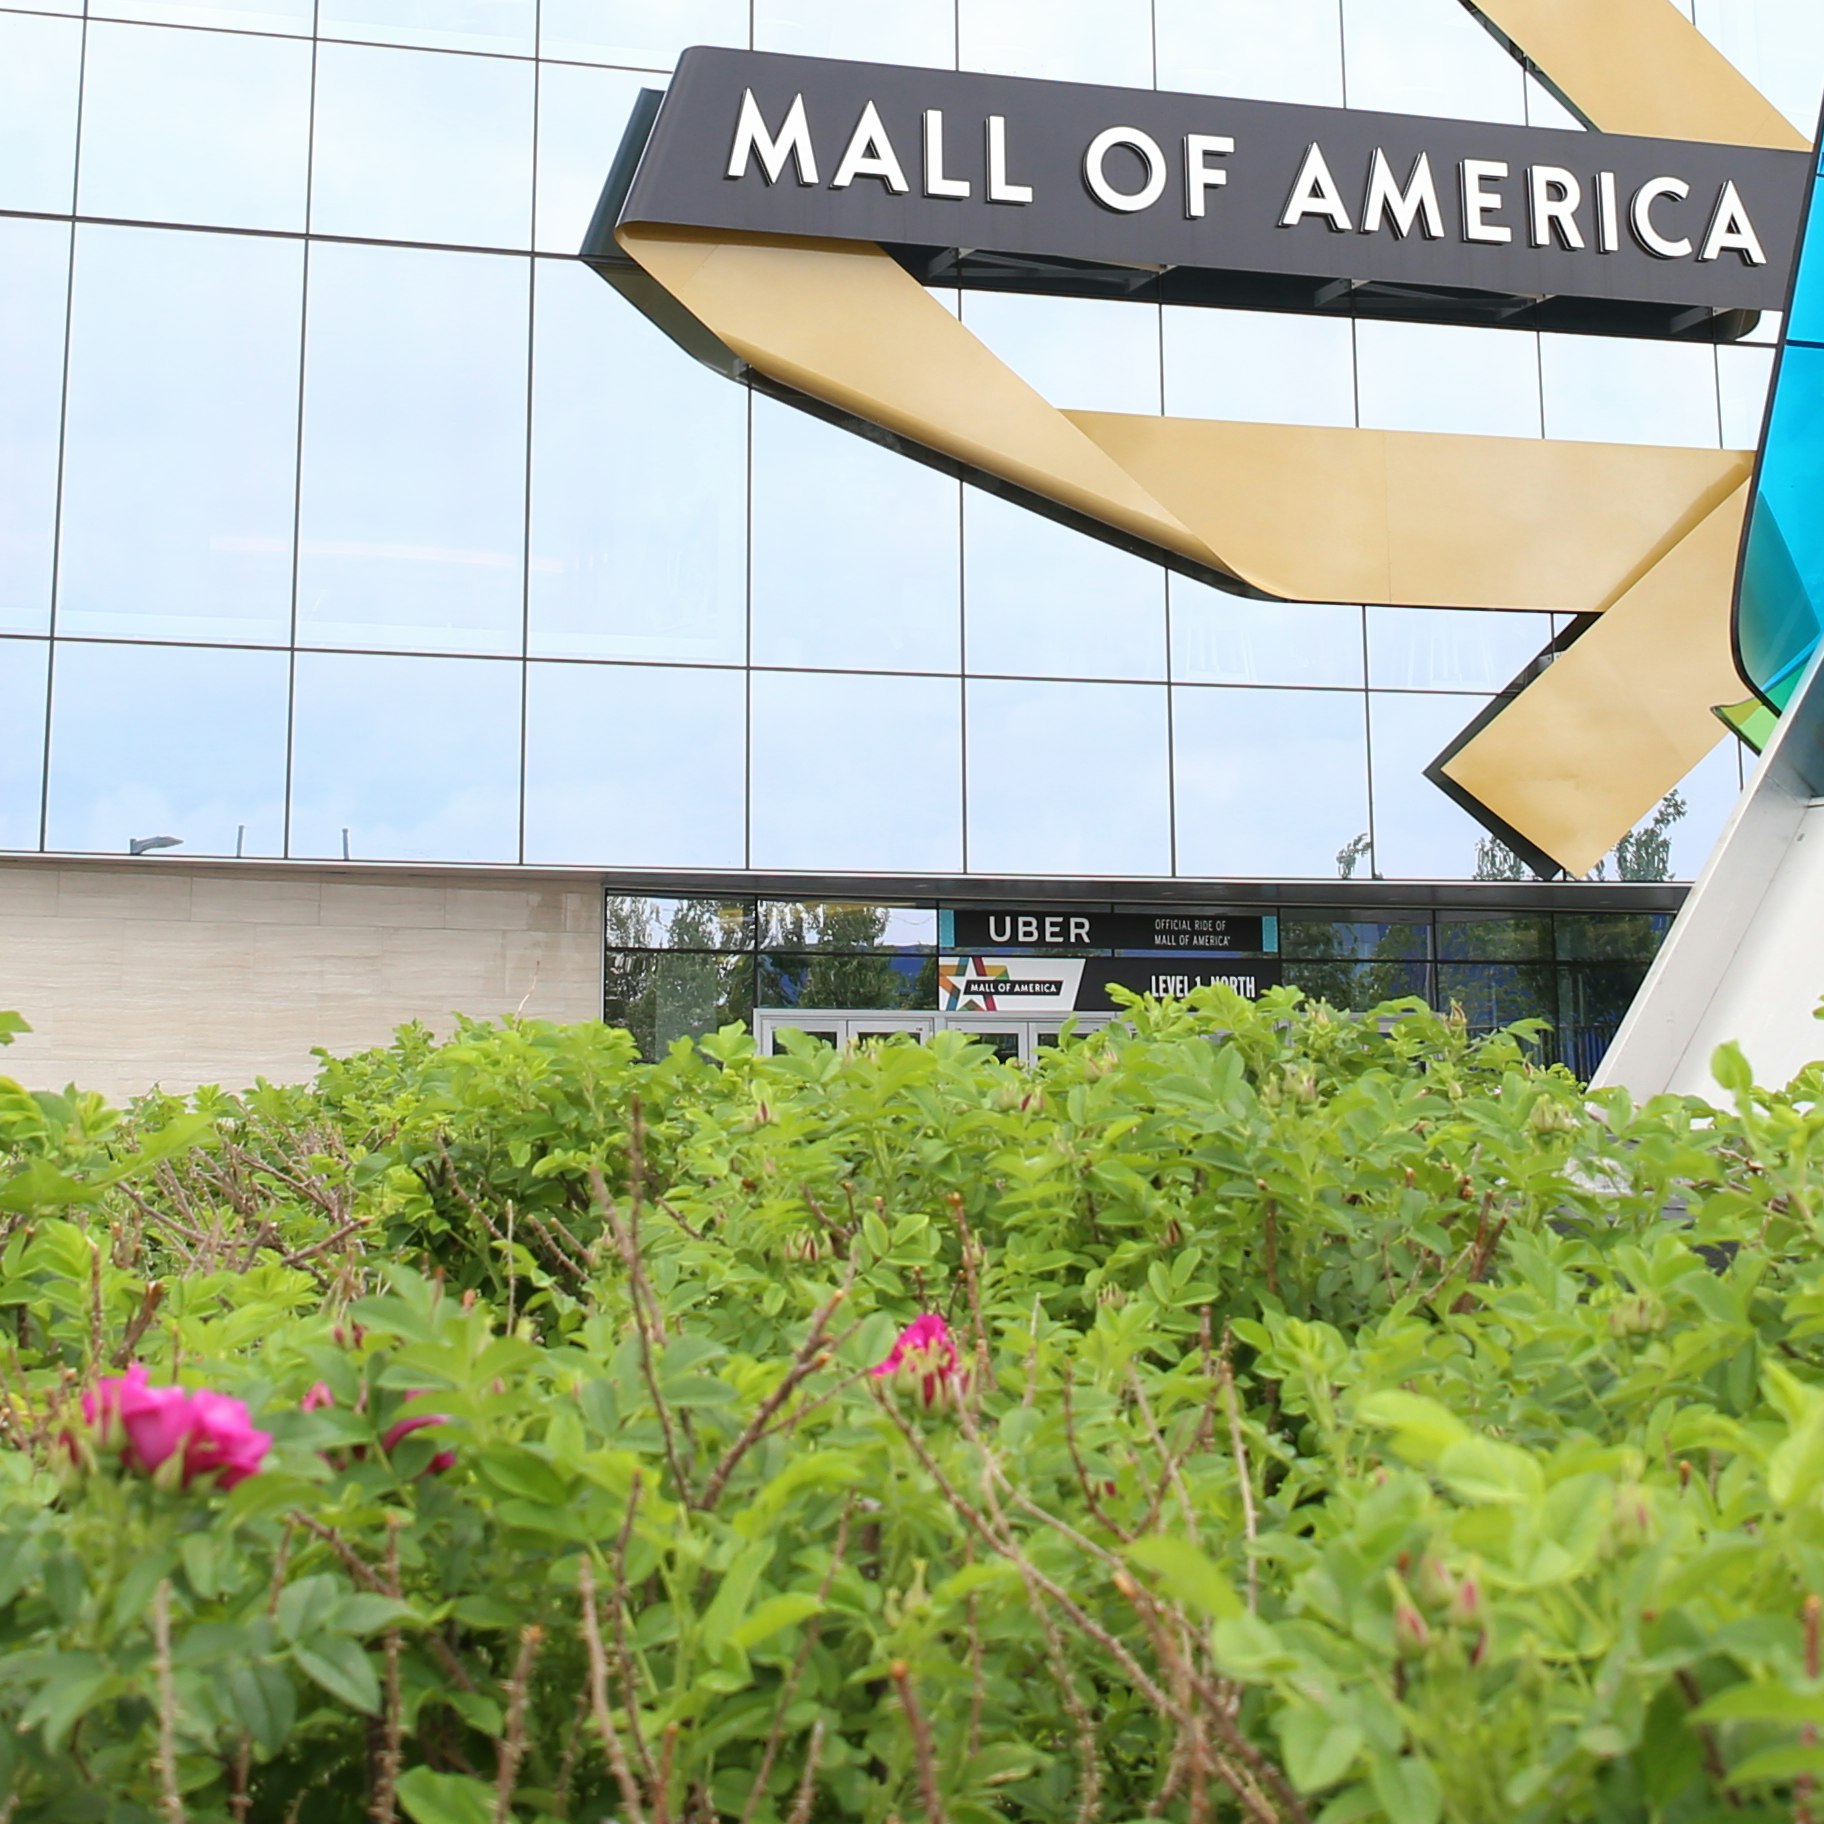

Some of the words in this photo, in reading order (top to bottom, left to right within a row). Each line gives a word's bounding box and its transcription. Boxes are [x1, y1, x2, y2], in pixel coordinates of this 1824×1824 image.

[725, 87, 1034, 205] MALL
[1083, 125, 1236, 219] OF
[1279, 141, 1767, 266] AMERICA
[988, 915, 1091, 944] UBER
[1154, 918, 1191, 931] OFFICIAL
[1194, 919, 1213, 931] RIDE
[1215, 920, 1226, 932] OF
[1154, 934, 1177, 946] MALL
[1179, 934, 1190, 946] OF
[970, 983, 995, 993] MALL
[997, 983, 1011, 993] OF
[1013, 983, 1057, 993] AMERICA
[1151, 975, 1189, 998] LEVEL
